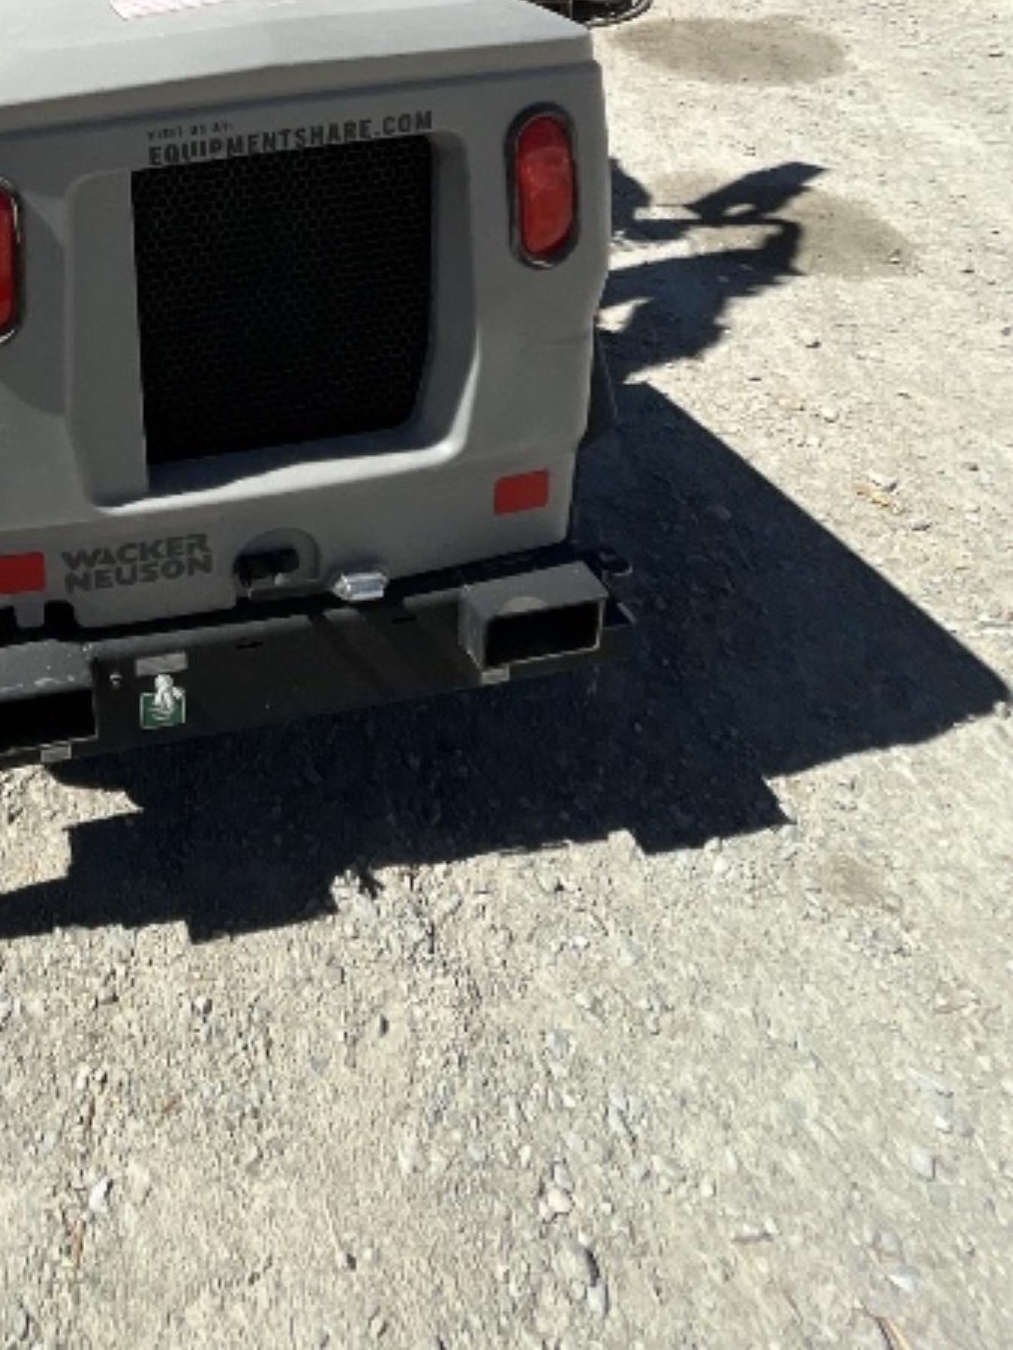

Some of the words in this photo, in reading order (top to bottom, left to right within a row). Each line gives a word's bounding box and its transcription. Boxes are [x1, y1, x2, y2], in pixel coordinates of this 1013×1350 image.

[148, 110, 433, 166] EQUIPMENTSHARE.COM
[61, 533, 213, 570] WACKER
[64, 554, 213, 593] NEUSON
